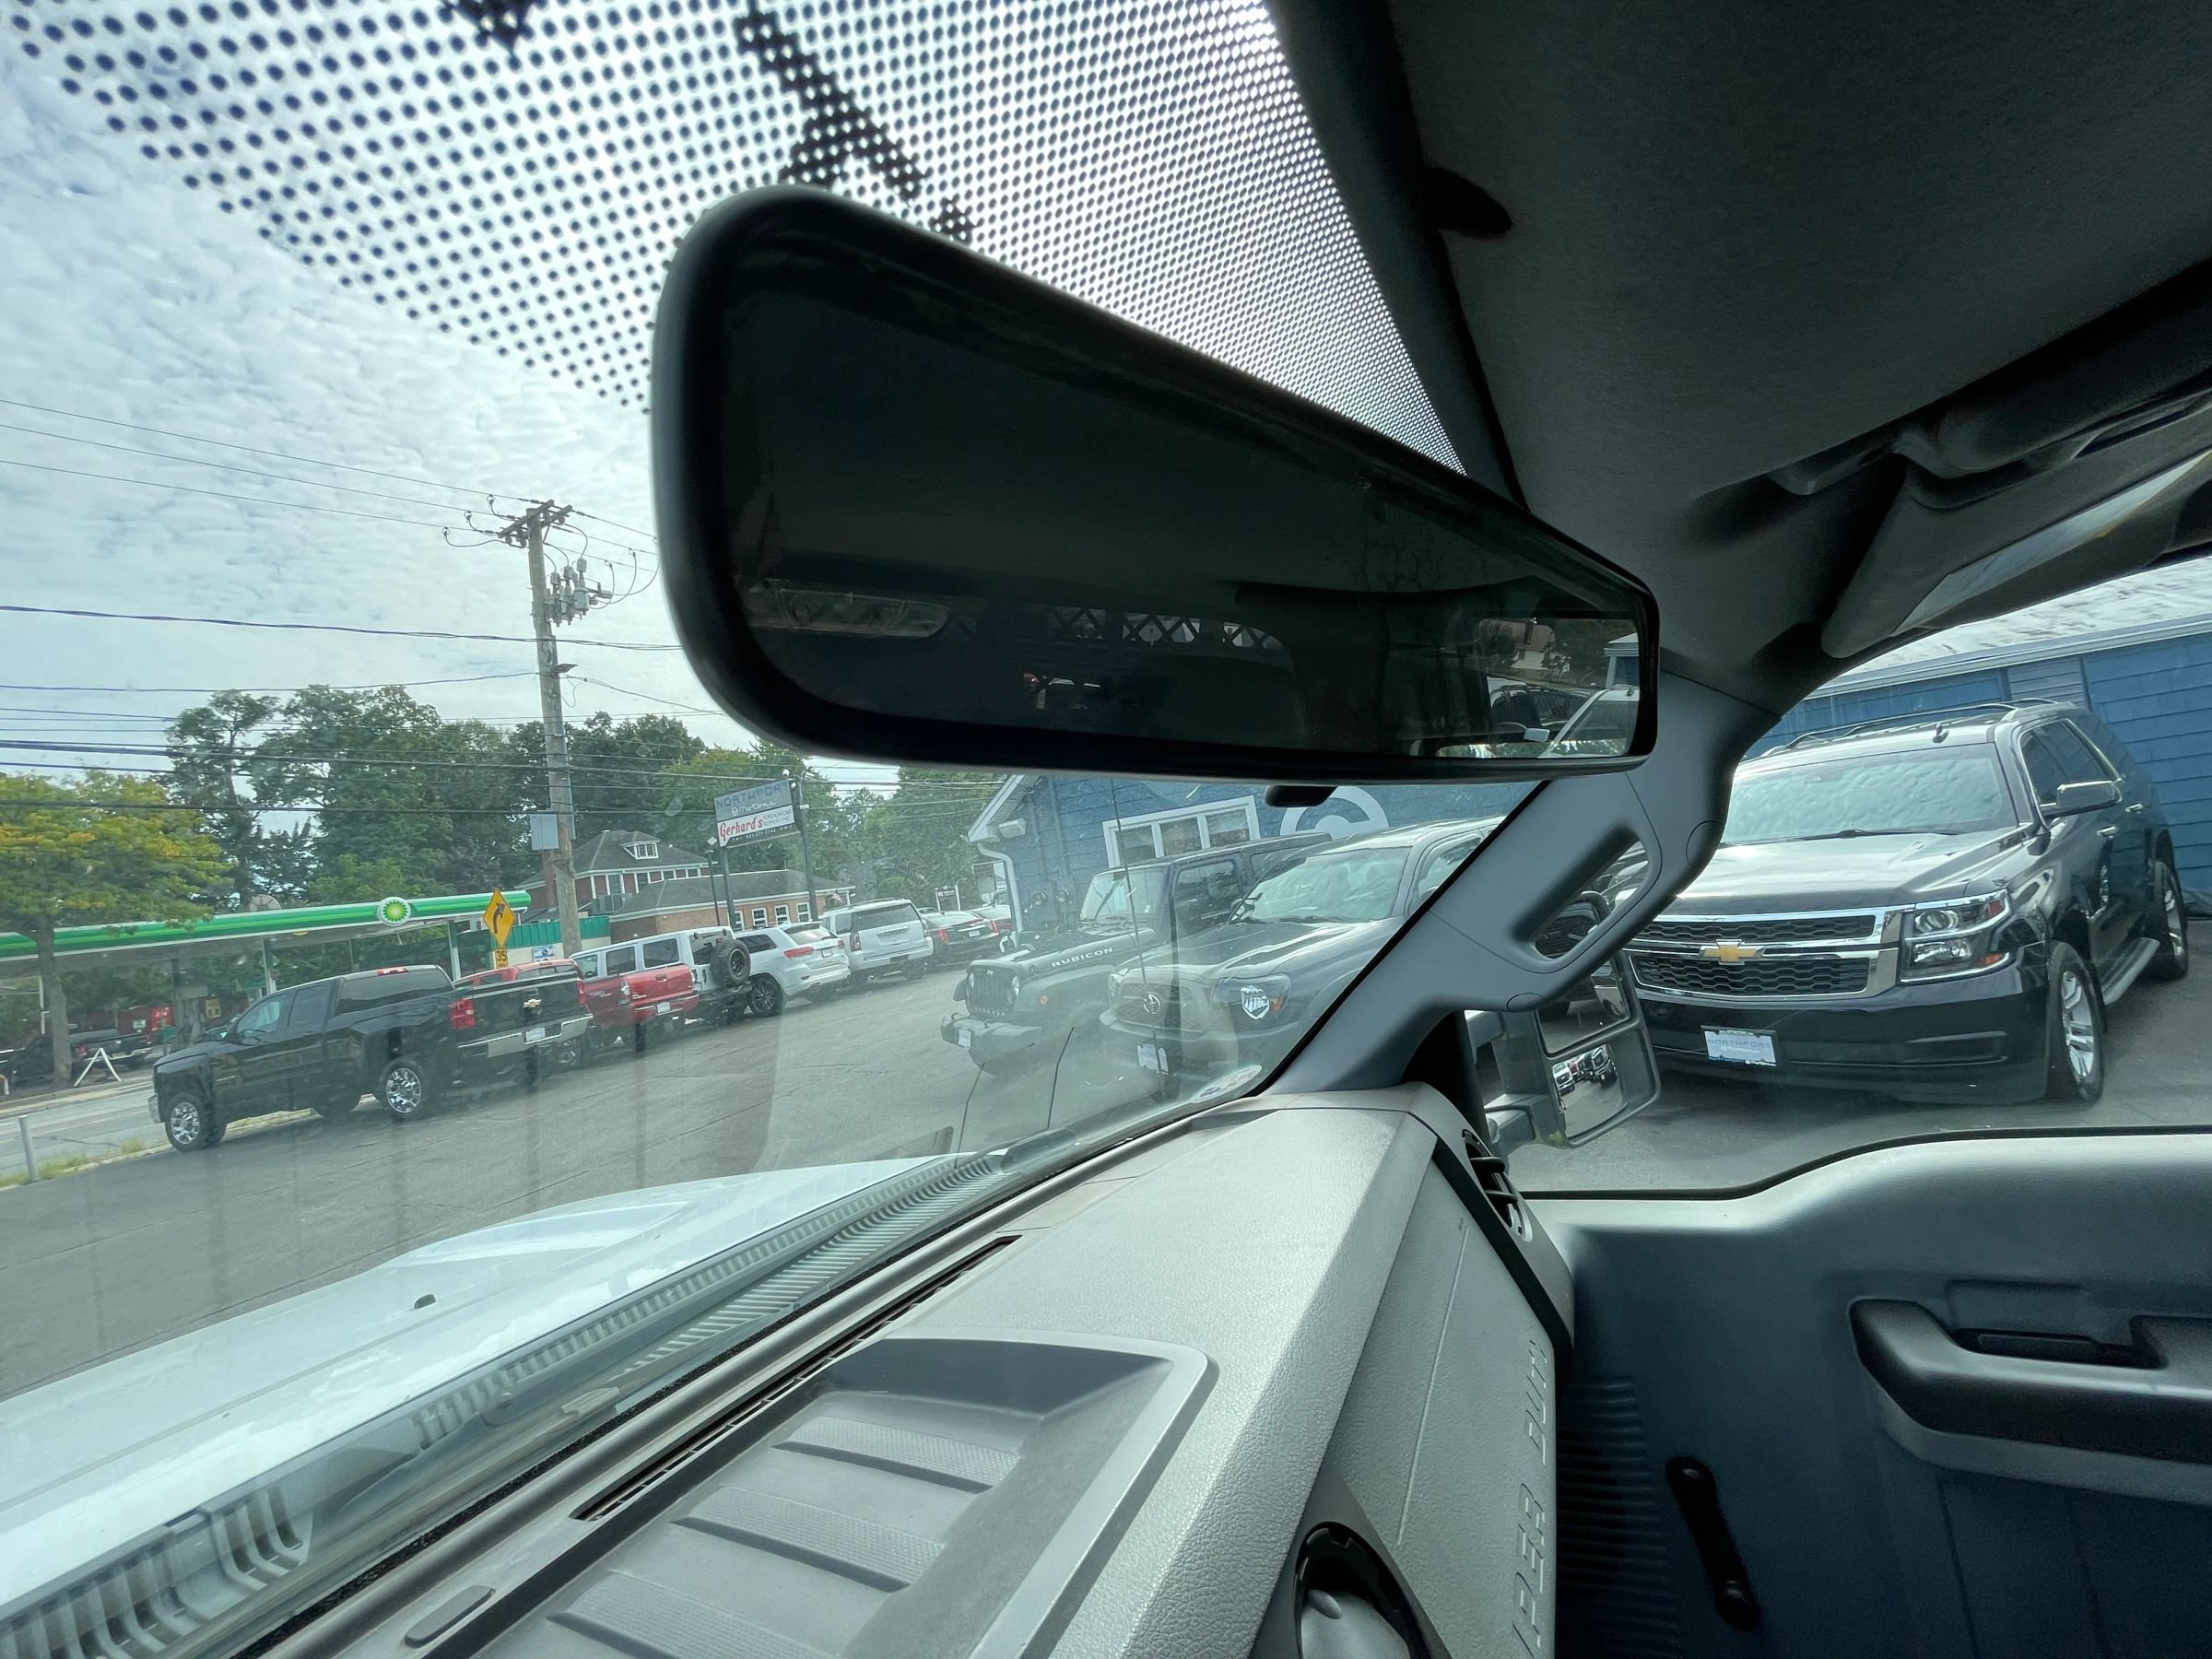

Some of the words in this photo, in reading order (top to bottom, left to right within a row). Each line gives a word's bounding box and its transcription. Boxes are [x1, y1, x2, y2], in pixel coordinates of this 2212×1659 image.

[716, 782, 788, 808] NORTHPORT
[720, 817, 763, 841] Gerhard's
[496, 950, 507, 961] 35
[1052, 947, 1113, 967] RUBICON
[1708, 1039, 1771, 1049] NORTHPORT
[1525, 1339, 1547, 1465] DUTY
